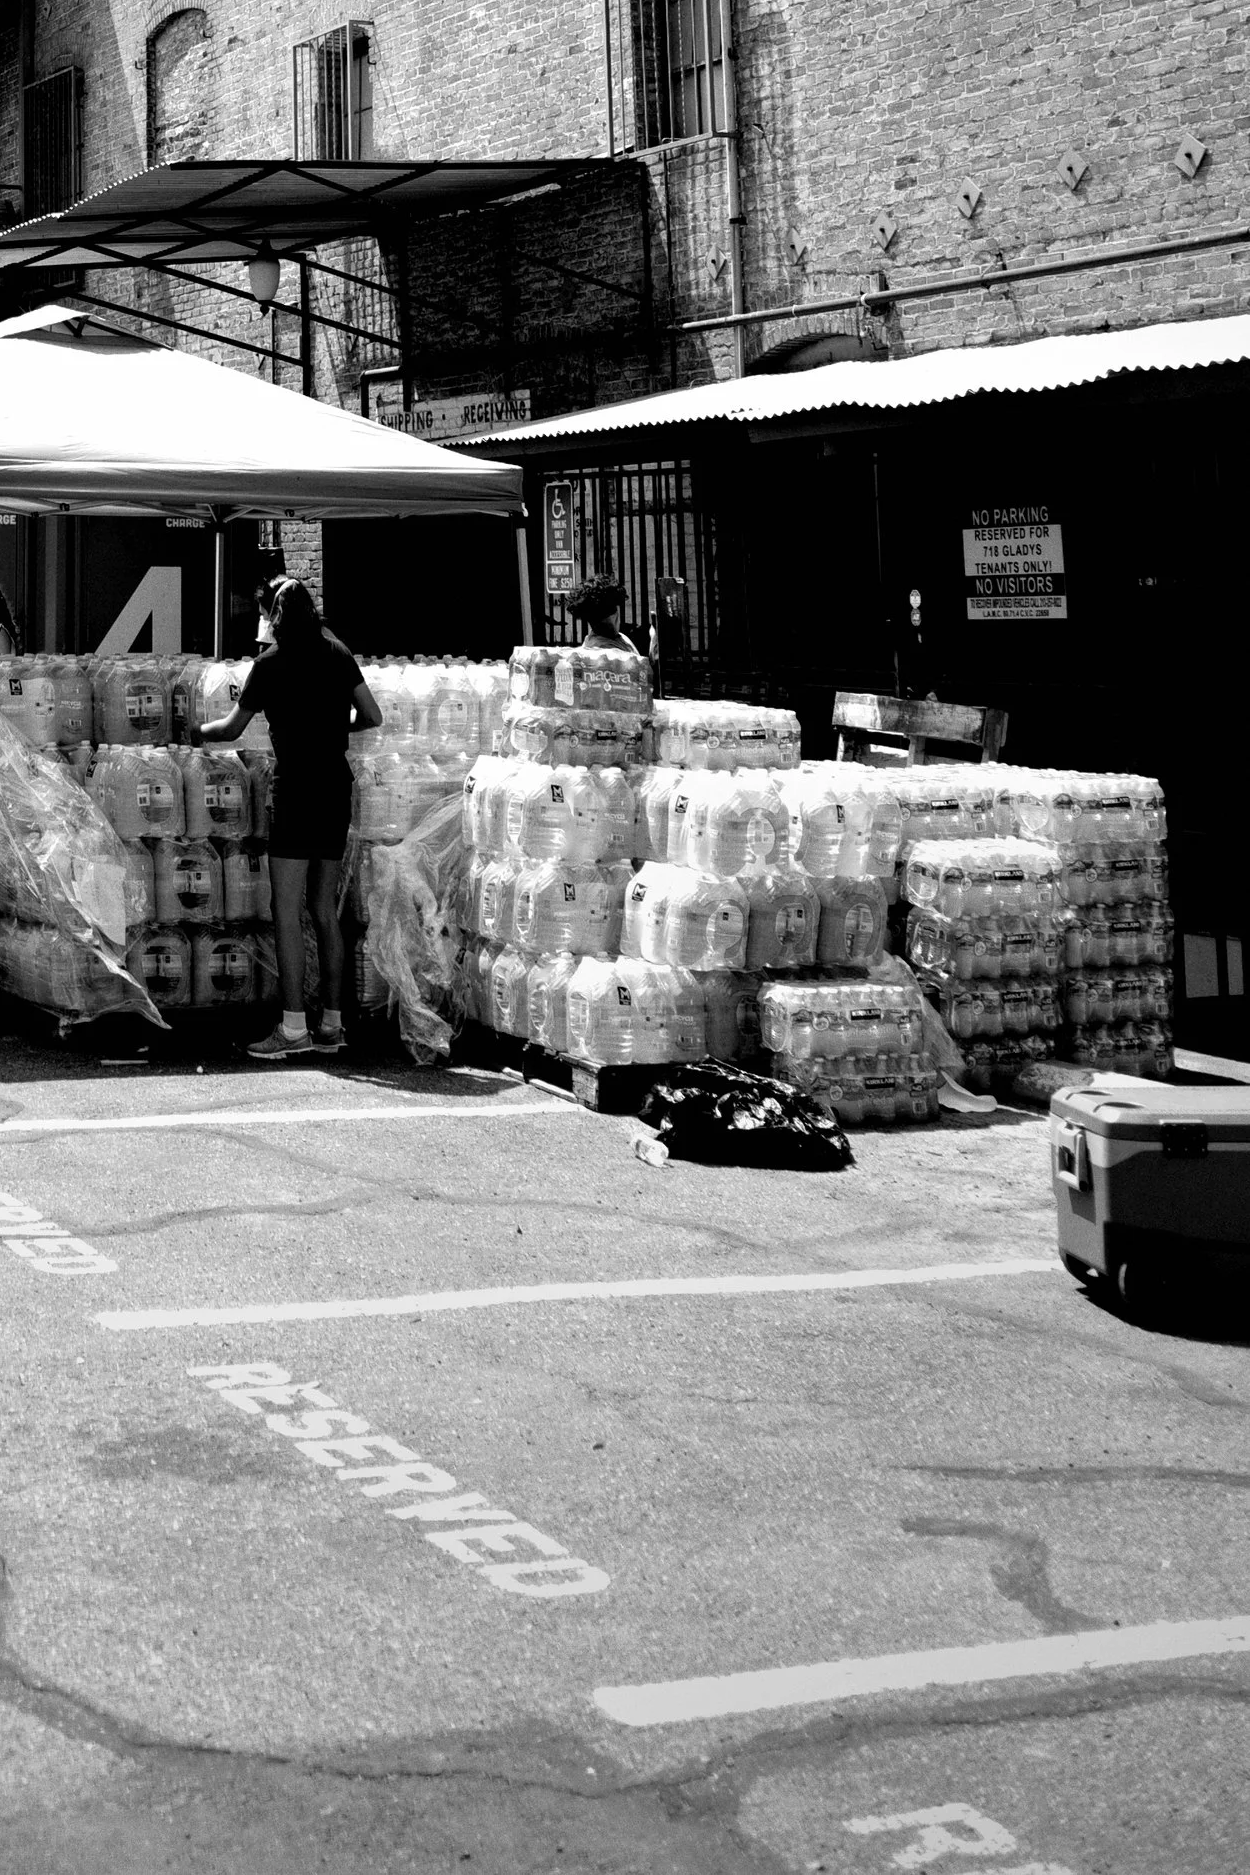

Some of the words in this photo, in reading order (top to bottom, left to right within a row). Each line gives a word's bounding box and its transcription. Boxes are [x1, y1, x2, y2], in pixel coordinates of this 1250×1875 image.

[381, 410, 433, 429] SHIPPING
[463, 400, 527, 424] RECEIVING
[166, 518, 206, 528] CHARGE
[972, 509, 990, 525] NO
[993, 506, 1049, 525] PARKING
[974, 528, 1026, 541] RESERVED
[1029, 526, 1050, 538] FOR
[983, 546, 999, 557] 718
[1002, 544, 1042, 557] GLADYS
[975, 561, 1020, 574] TENANTS
[1023, 561, 1052, 573] ONLY!
[976, 578, 993, 594] NO
[996, 576, 1054, 594] VISITORS
[96, 566, 182, 653] 4
[583, 669, 631, 687] niagara
[186, 1362, 611, 1598] RESERVED
